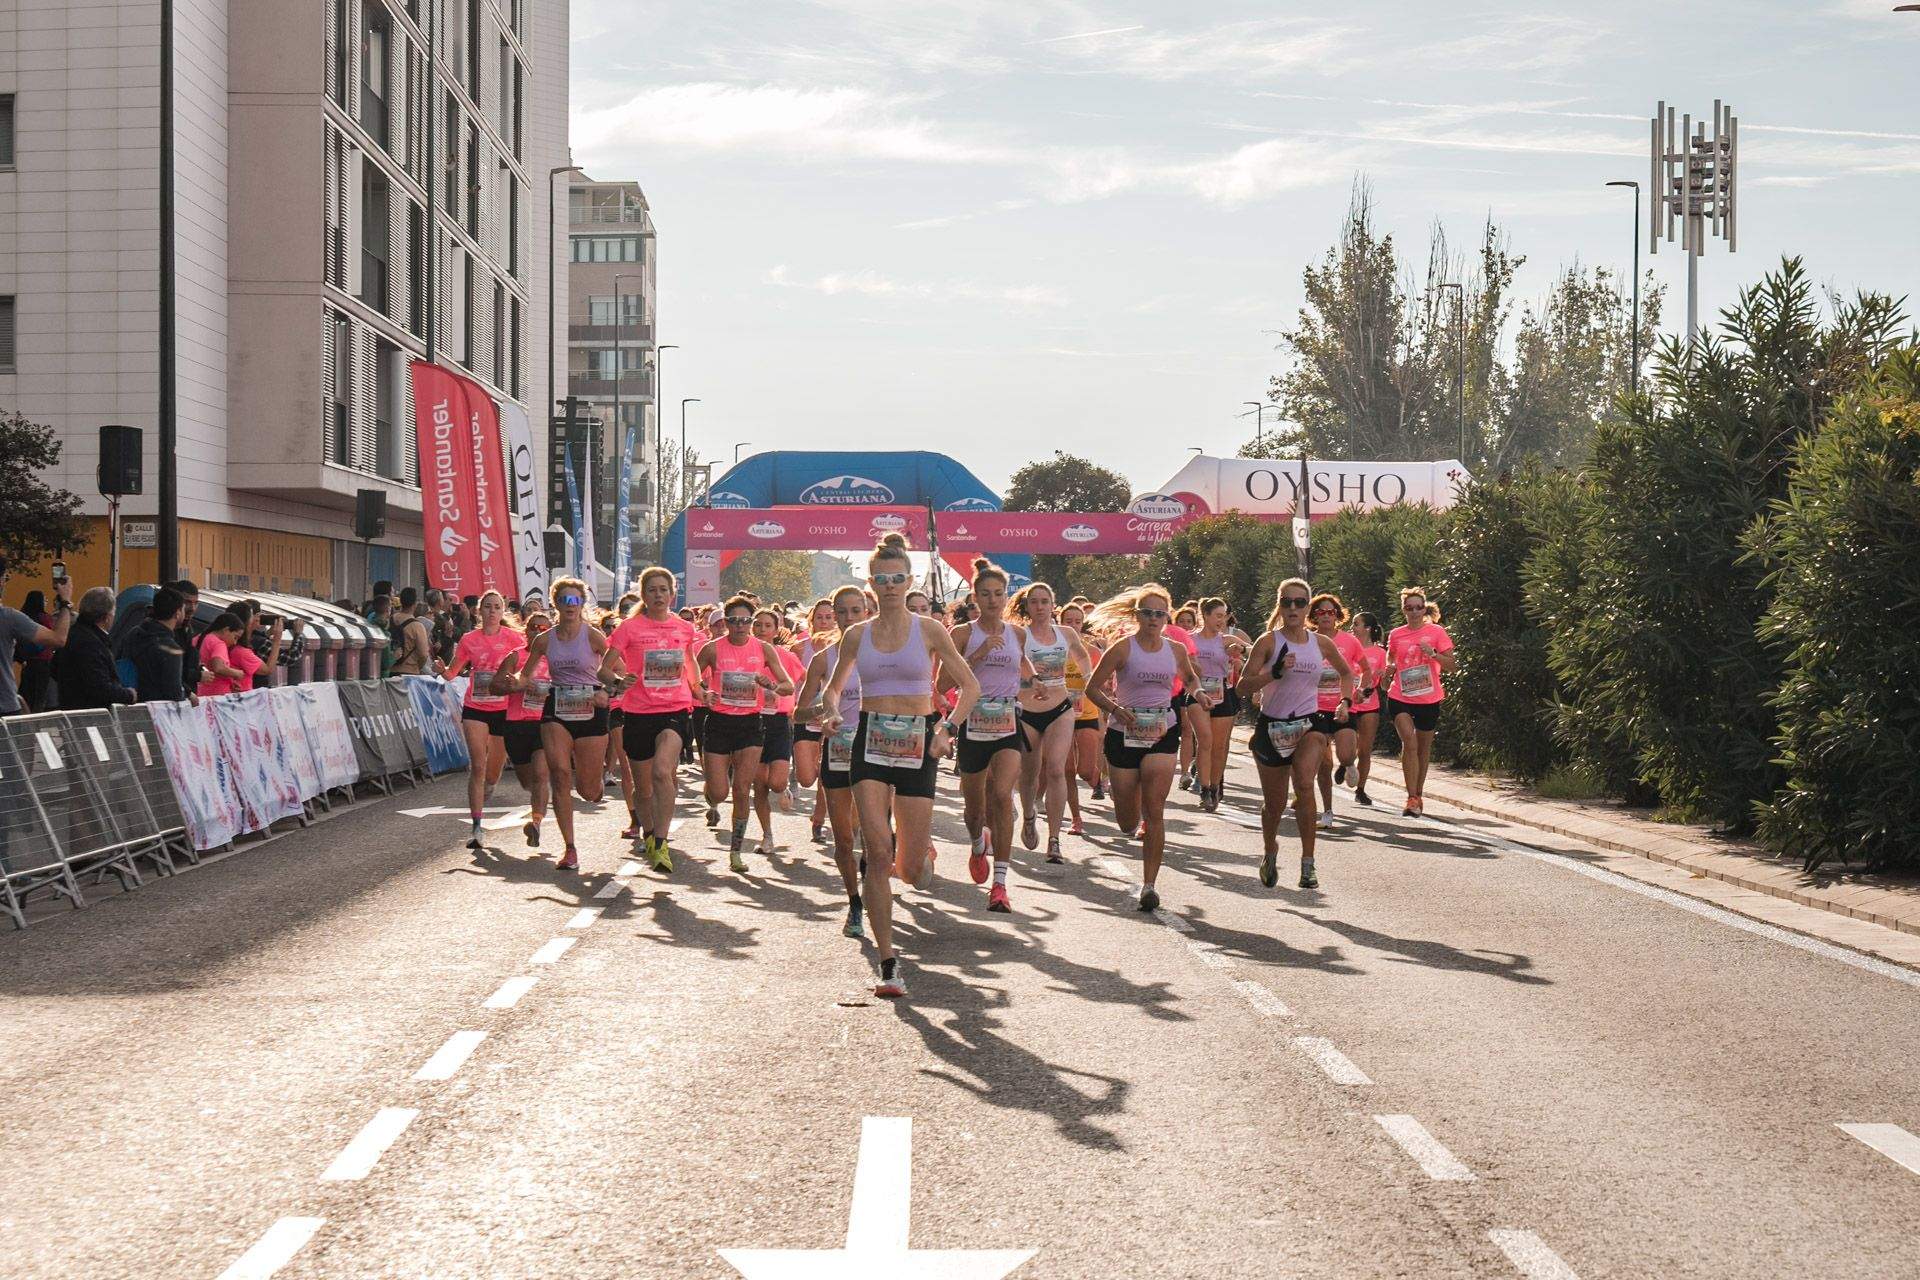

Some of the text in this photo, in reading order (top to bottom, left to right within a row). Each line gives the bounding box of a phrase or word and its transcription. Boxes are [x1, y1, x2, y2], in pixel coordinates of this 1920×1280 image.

[1245, 469, 1406, 505] OYSHO
[809, 492, 887, 504] ASTURIANA
[1136, 504, 1182, 514] ASTURIANA
[808, 526, 847, 535] OYSHO
[1127, 518, 1172, 533] Carrera
[1000, 528, 1038, 537] OYSHO
